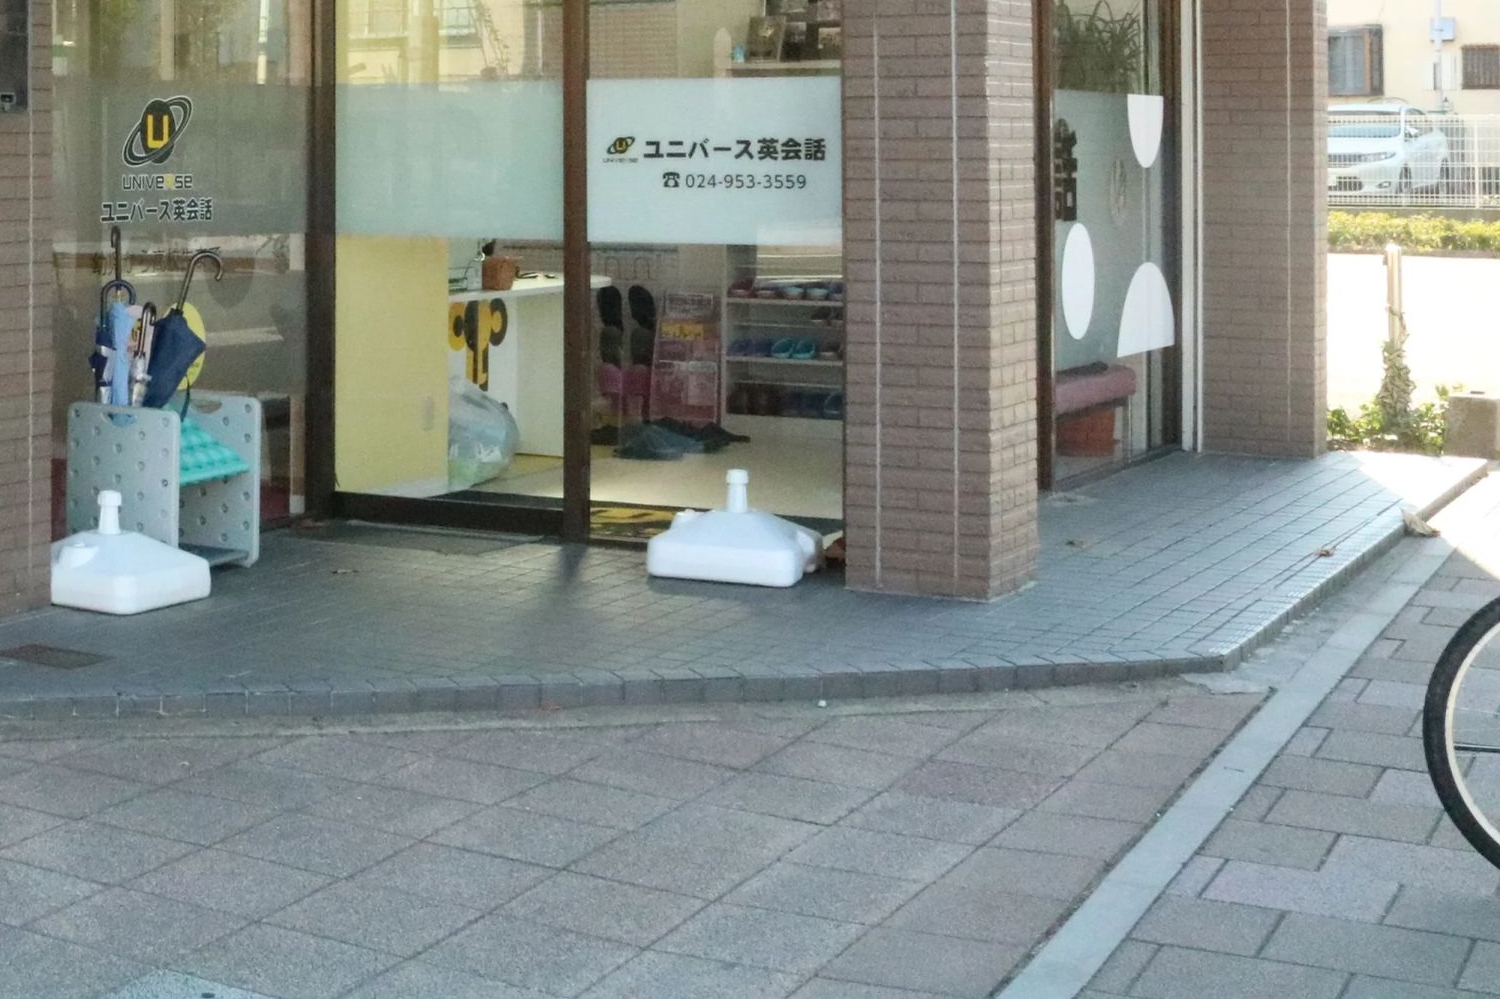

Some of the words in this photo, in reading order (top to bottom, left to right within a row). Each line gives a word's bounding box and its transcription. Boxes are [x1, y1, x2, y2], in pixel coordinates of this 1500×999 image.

[643, 137, 827, 162] ユニバース英会話
[685, 173, 807, 190] 024-953-3559
[100, 199, 213, 222] ユニバース英会話
